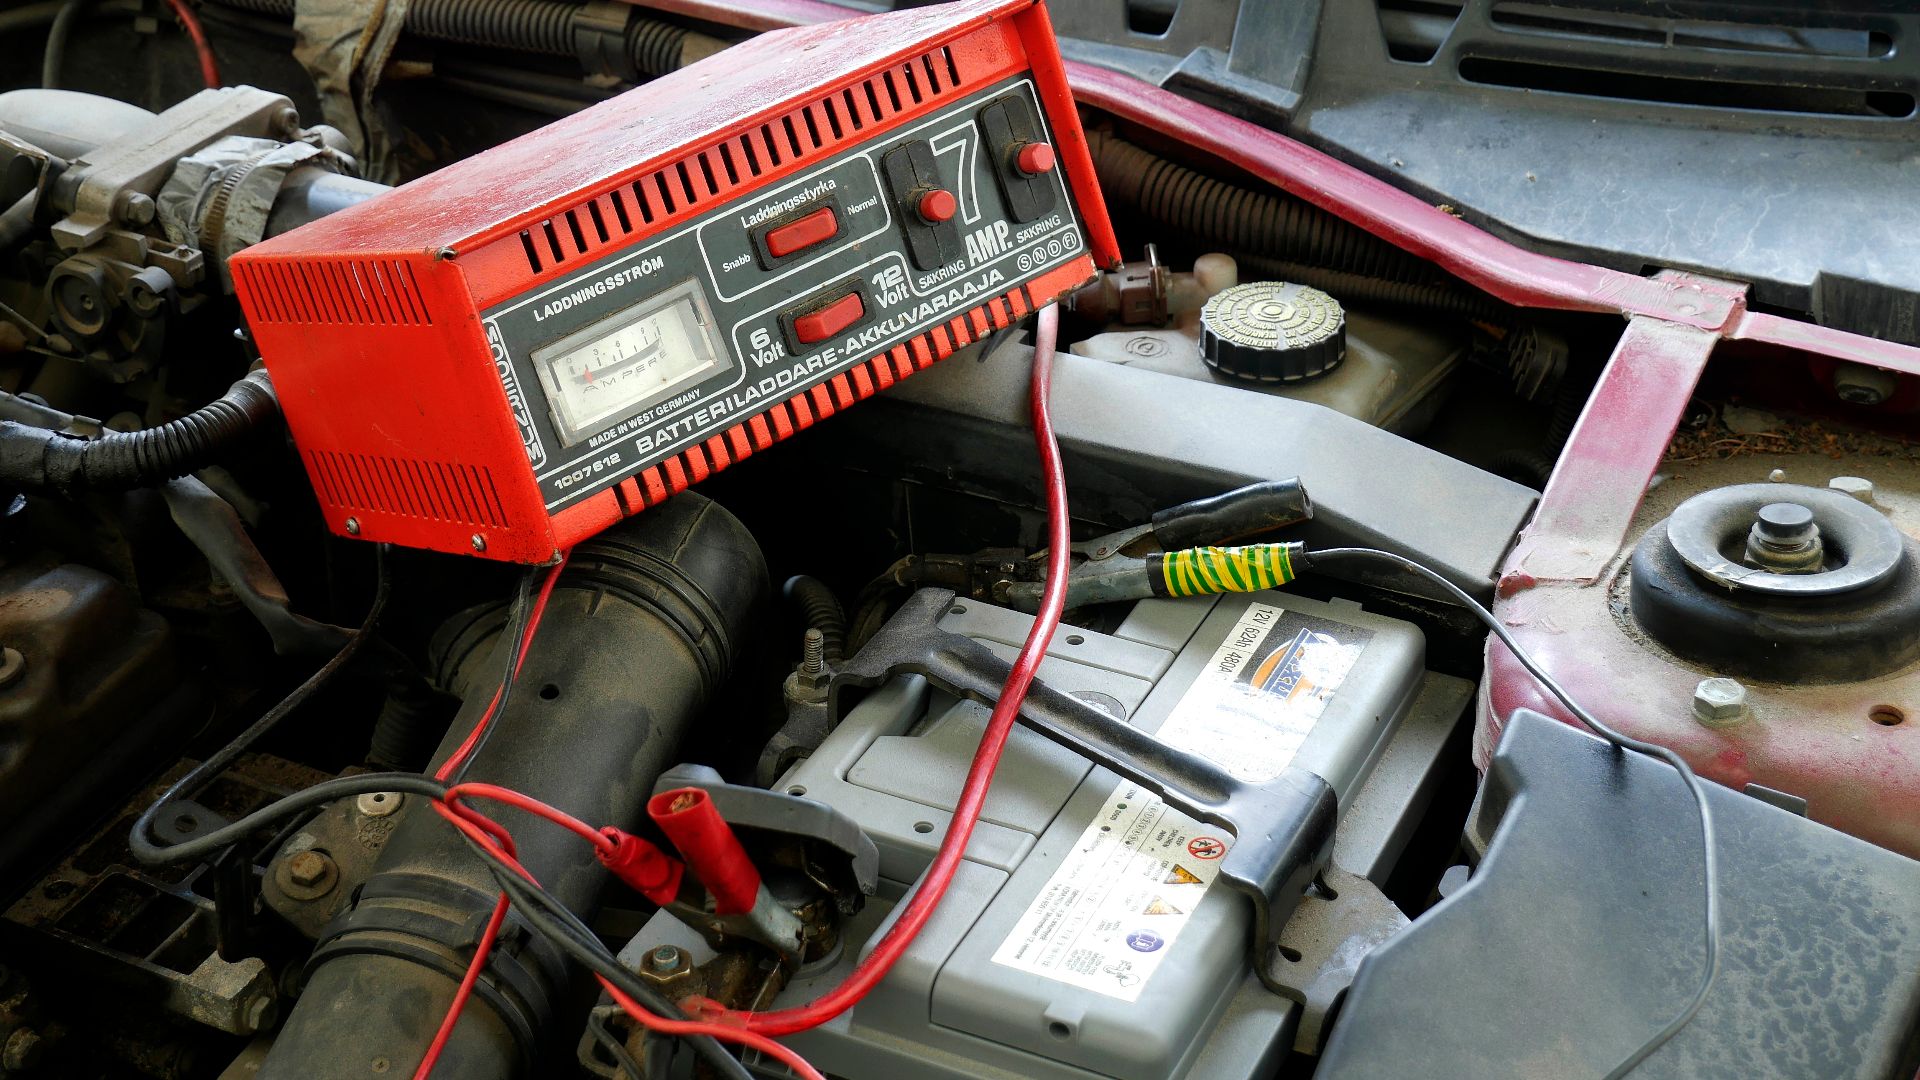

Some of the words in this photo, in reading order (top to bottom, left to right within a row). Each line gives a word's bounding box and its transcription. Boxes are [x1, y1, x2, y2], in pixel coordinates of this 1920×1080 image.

[930, 119, 979, 226] 7
[740, 177, 837, 229] Laddningsstyrka
[847, 196, 878, 216] Normal
[964, 220, 1013, 267] AMP.
[1016, 214, 1061, 244] SÄKRING
[722, 252, 751, 273] Snabb
[918, 260, 966, 290] SÄKRING
[533, 256, 664, 322] LADDNINGSSTRÖM
[872, 264, 904, 292] 12
[875, 280, 910, 310] Volt
[750, 327, 771, 349] 6
[636, 268, 1005, 456] BATTERILADDARE-AKKUVARAAJA
[750, 342, 786, 370] Volt
[583, 351, 668, 394] AMPERE
[588, 429, 617, 448] MADE
[617, 424, 629, 436] IN
[628, 410, 656, 432] WEST
[656, 390, 702, 418] GERMANY
[554, 453, 622, 490] 1007612
[1252, 608, 1273, 625] 12V
[1236, 626, 1260, 648] 62Ah
